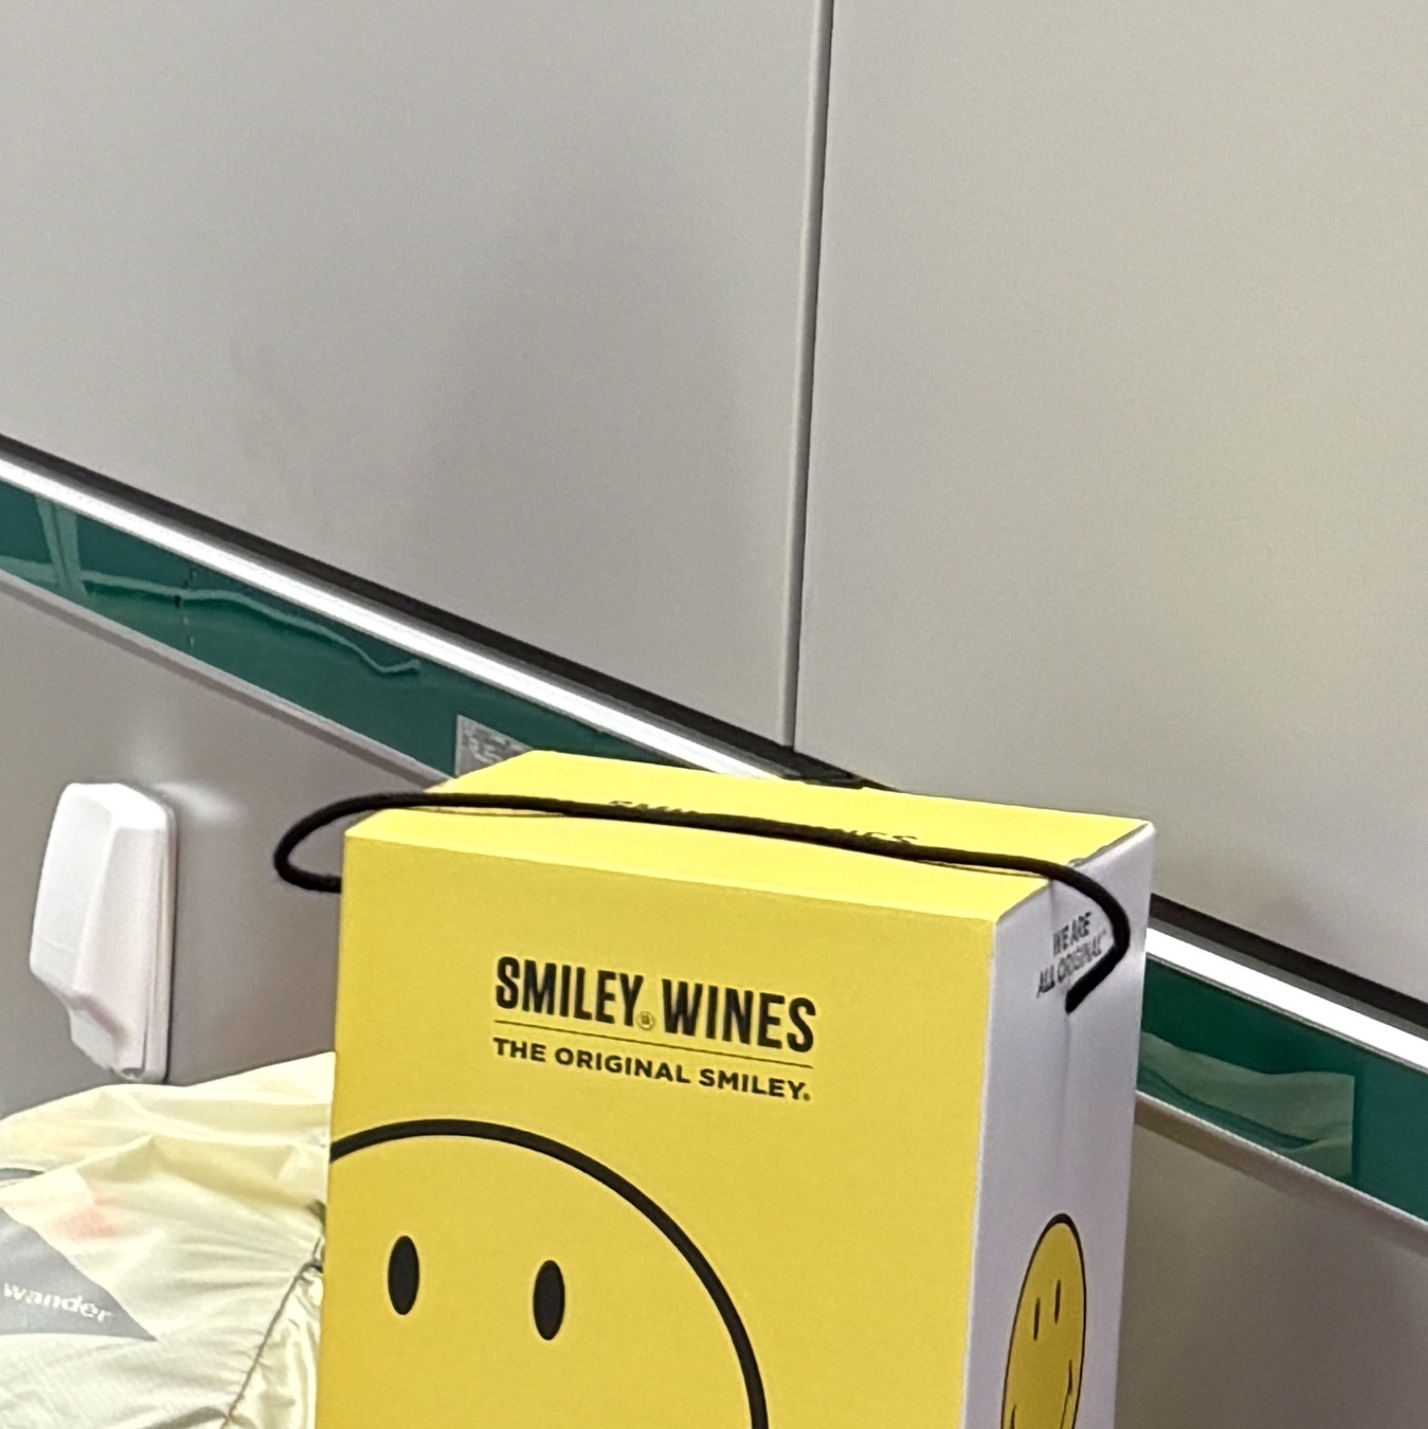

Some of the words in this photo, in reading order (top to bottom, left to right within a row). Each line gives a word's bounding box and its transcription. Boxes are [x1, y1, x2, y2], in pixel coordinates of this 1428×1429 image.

[661, 977, 817, 1053] WINES
[493, 1037, 547, 1063] THE
[554, 1047, 692, 1084] ORIGINAL
[3, 1281, 113, 1323] wander
